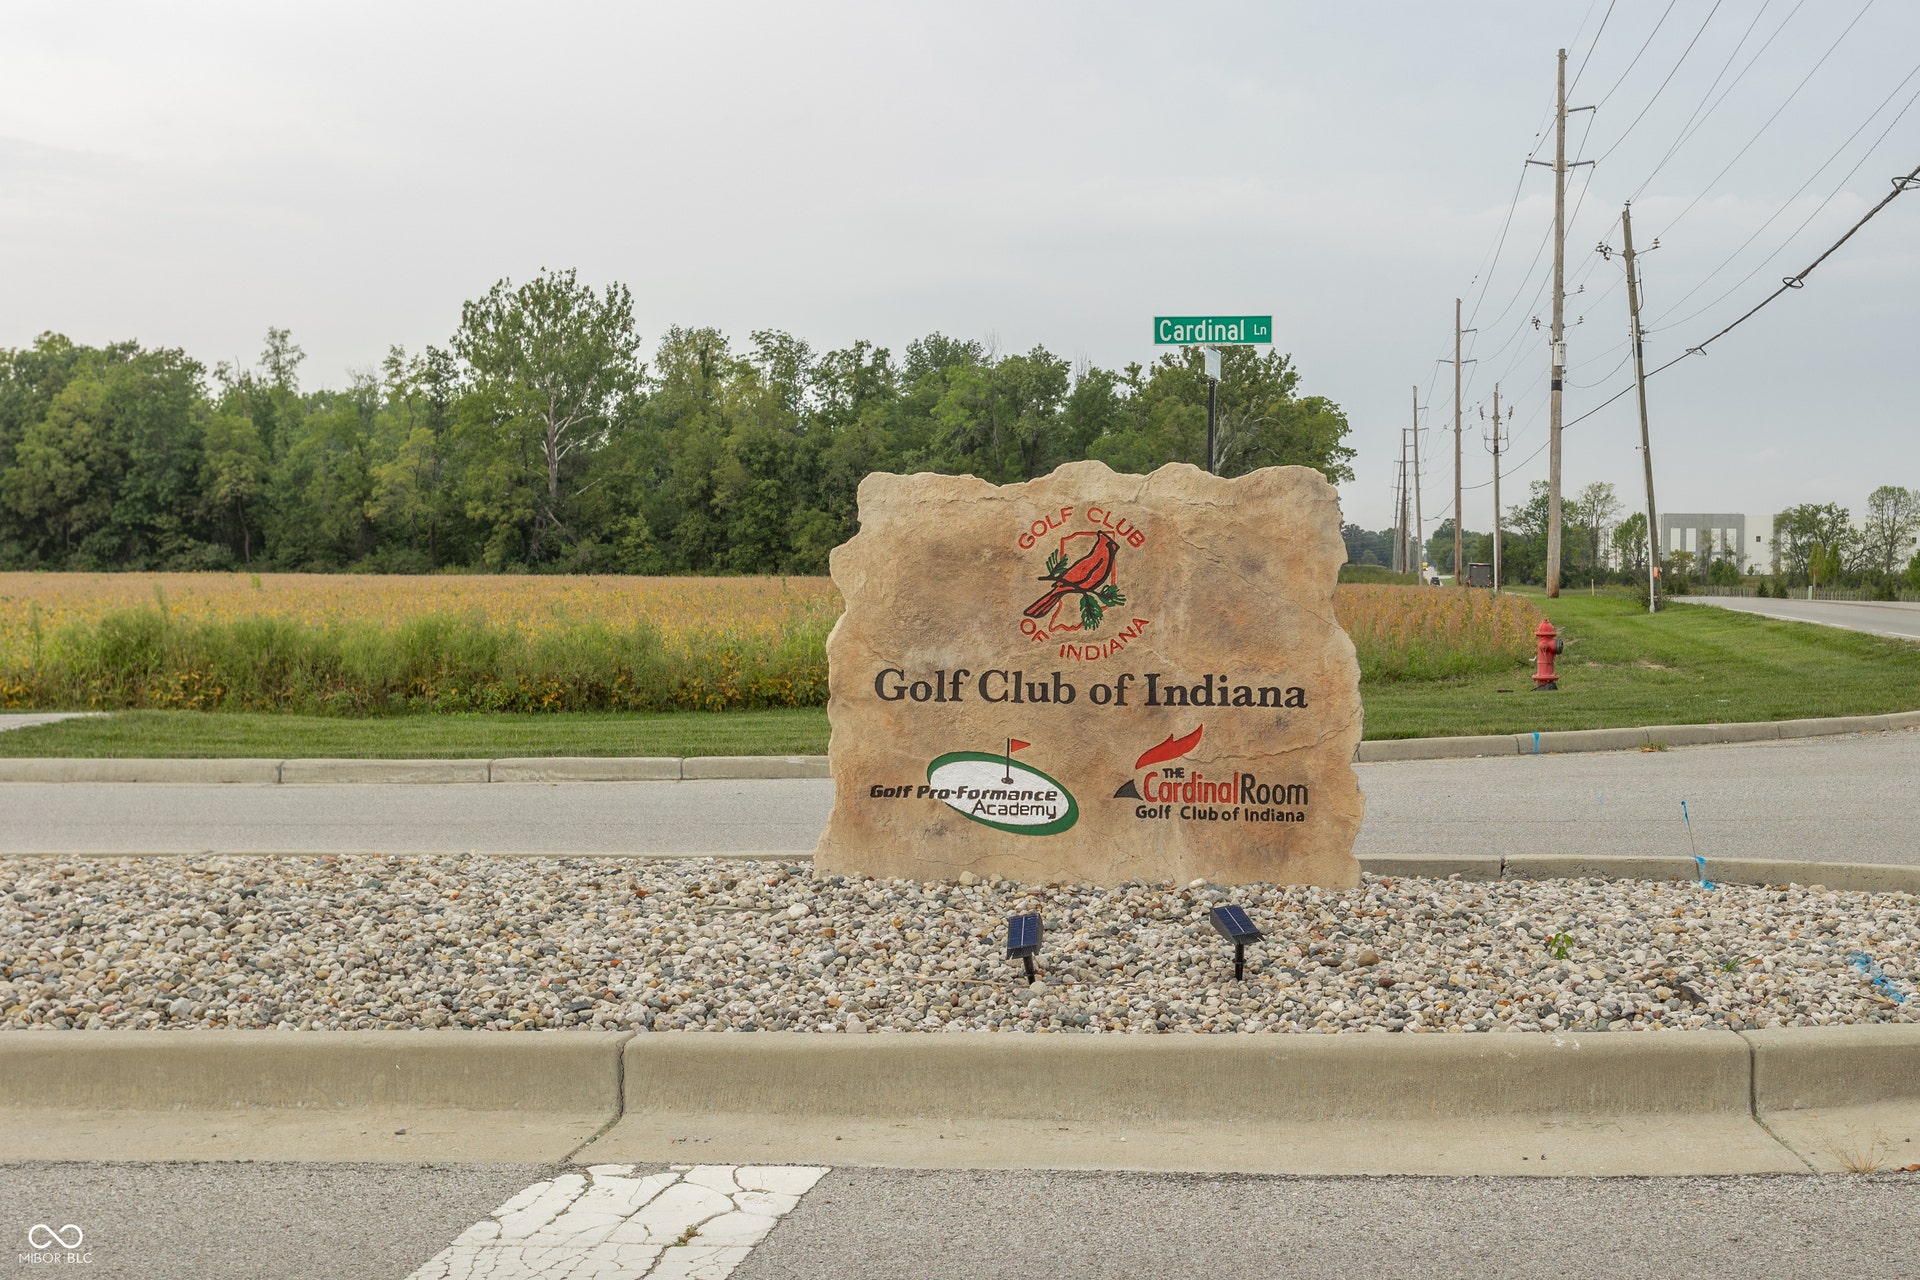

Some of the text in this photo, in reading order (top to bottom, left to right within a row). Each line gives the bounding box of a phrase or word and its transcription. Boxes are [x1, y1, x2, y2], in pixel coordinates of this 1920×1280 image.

[1159, 319, 1267, 341] Cardinal Ln
[1018, 506, 1146, 550] GOLF CLUB
[1020, 618, 1150, 661] OF INDIANA
[874, 668, 1309, 709] Golf Club of Indiana
[1162, 767, 1185, 779] THE
[870, 785, 1058, 802] Golf Pro-Formance
[971, 799, 1057, 820] Academy
[1135, 805, 1305, 822] Golf Club of Indiana
